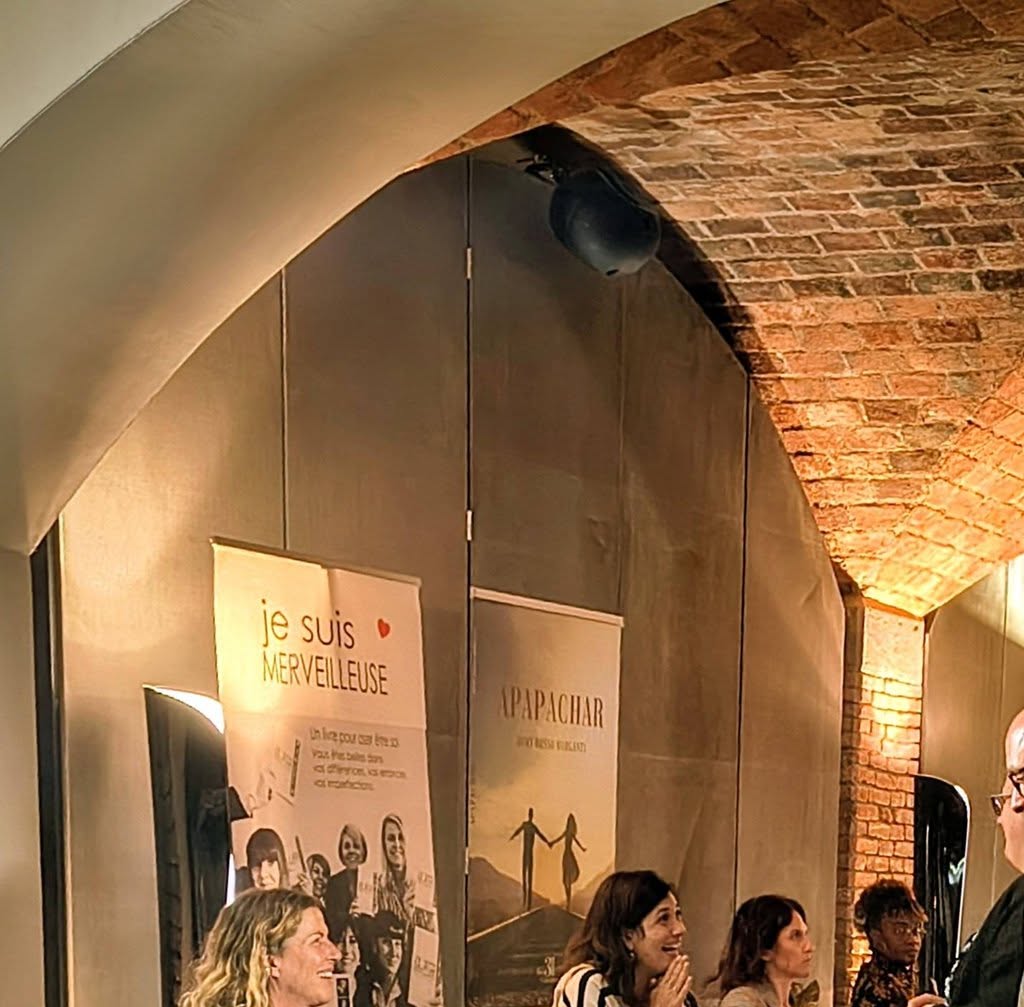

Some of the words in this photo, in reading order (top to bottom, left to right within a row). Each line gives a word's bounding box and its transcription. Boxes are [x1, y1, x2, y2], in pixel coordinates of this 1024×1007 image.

[262, 599, 288, 647] je
[302, 610, 355, 649] suis
[262, 651, 389, 696] MERVEILLEUSE
[498, 686, 604, 729] APAPACHAR
